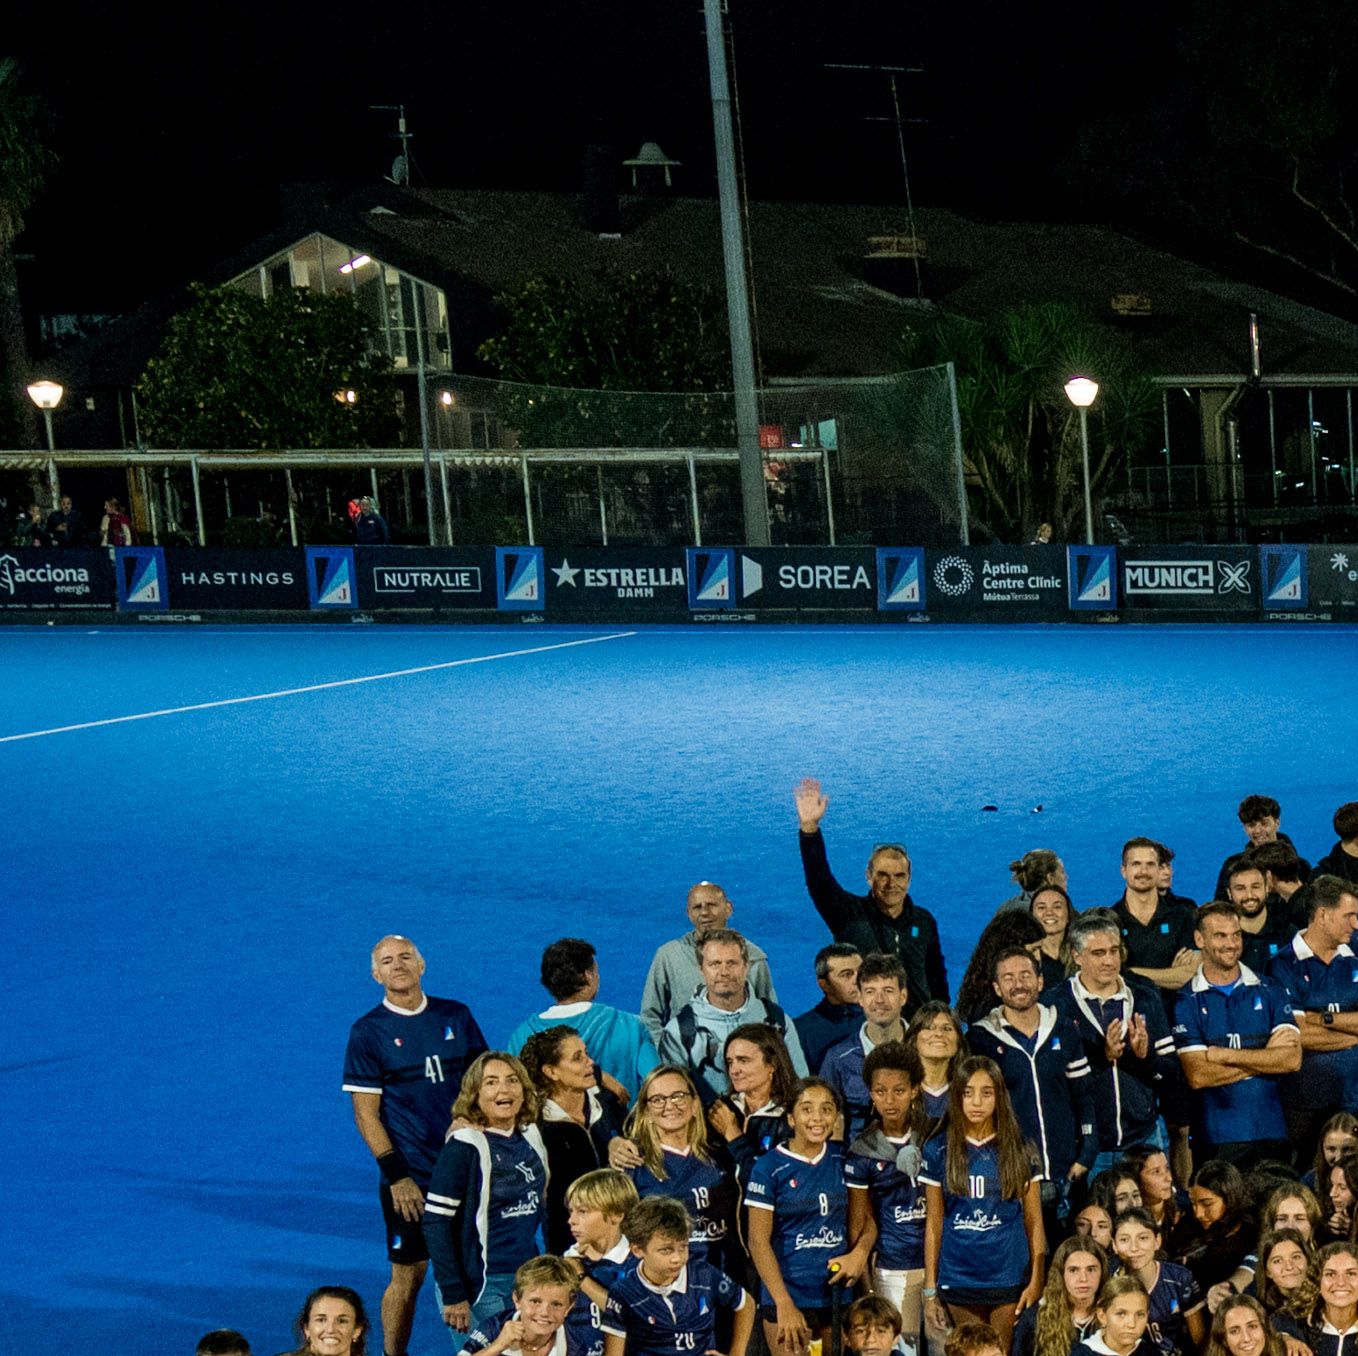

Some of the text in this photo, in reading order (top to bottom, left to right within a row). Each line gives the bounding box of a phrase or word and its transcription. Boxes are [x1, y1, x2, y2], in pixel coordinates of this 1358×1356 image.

[14, 564, 89, 583] acciona
[182, 572, 294, 585] HASTINGS
[384, 572, 471, 587] NUTRALIE
[584, 567, 686, 587] ESTRELLA
[778, 565, 872, 590] SOREA
[982, 576, 1025, 589] Centre
[1126, 566, 1214, 589] MUNICH
[54, 584, 90, 595] energía
[617, 587, 654, 598] DAMM
[139, 614, 201, 622] PORSCHE
[694, 613, 756, 622] PORSCHE
[1269, 612, 1332, 621] PORSCHE
[425, 1054, 444, 1084] 41
[969, 1175, 984, 1199] 10
[692, 1186, 710, 1209] 19
[820, 1192, 828, 1216] 8
[590, 1302, 600, 1328] 9
